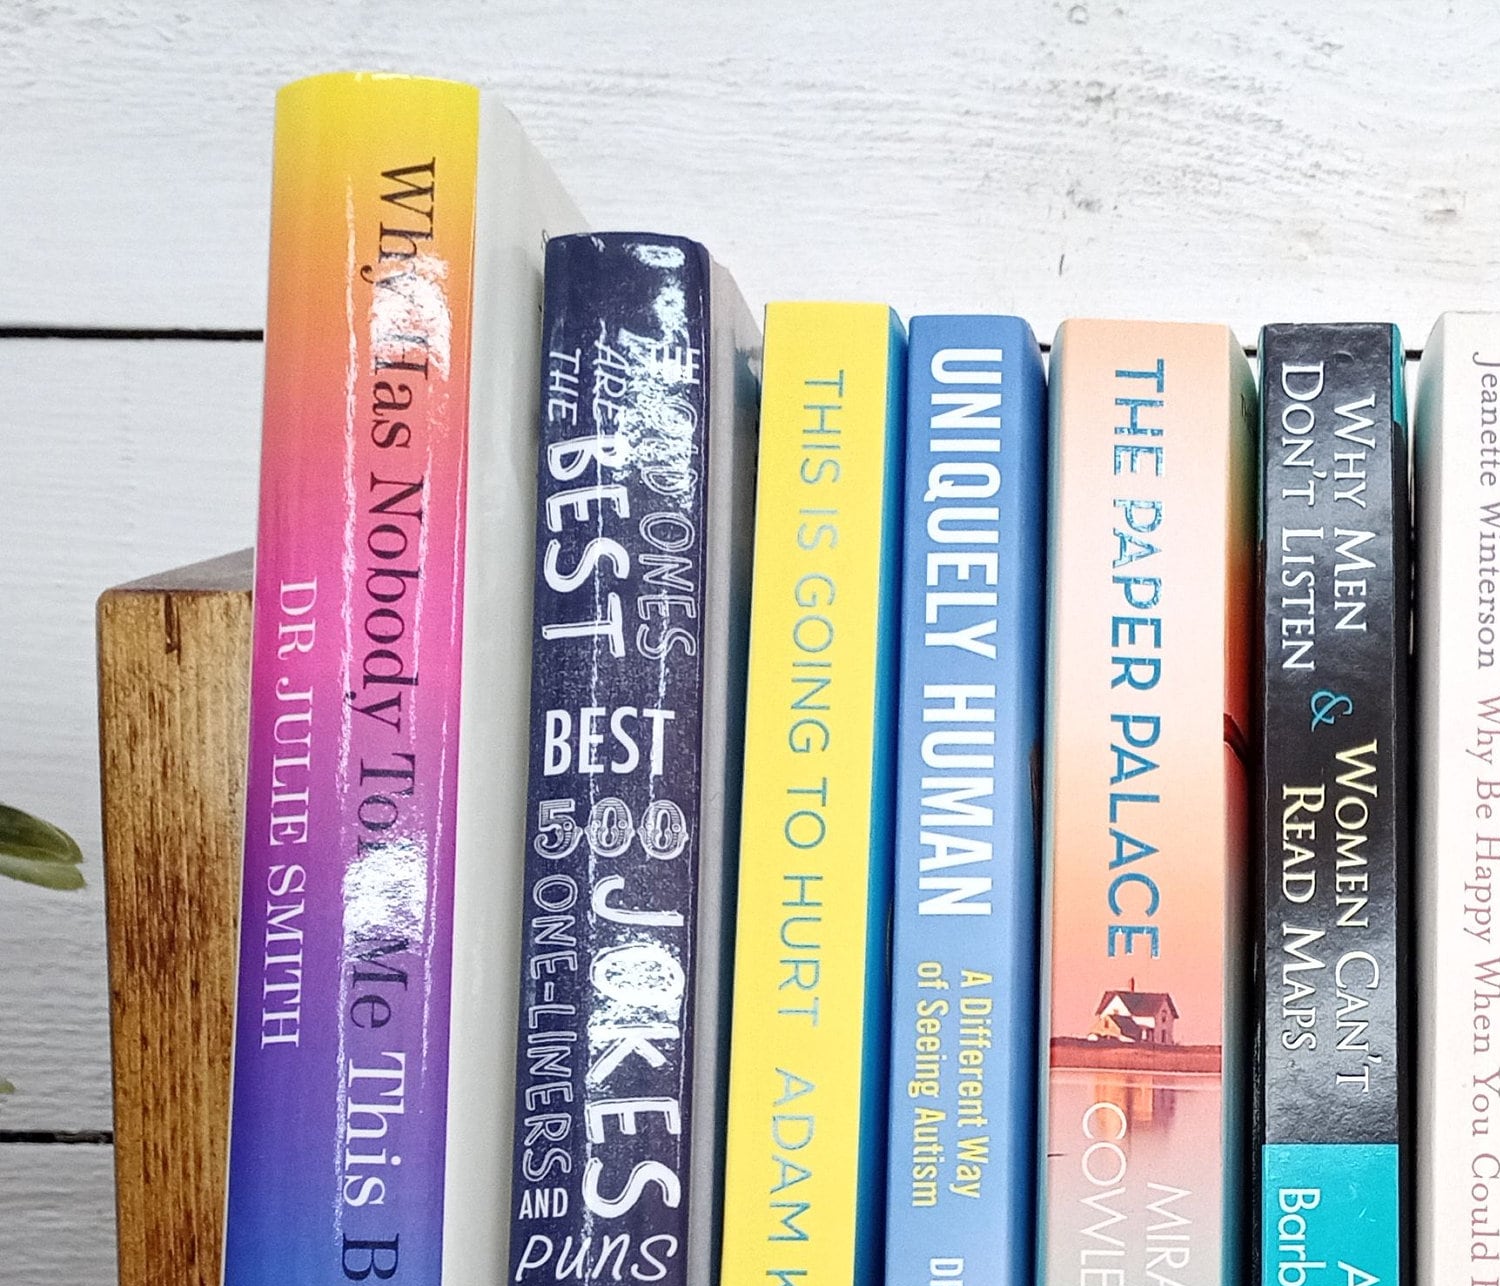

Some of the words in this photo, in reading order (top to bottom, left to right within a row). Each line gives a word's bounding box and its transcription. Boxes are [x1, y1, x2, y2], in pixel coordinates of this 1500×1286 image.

[360, 156, 436, 299] Why
[369, 331, 430, 449] Has
[547, 347, 582, 426] THE
[592, 341, 630, 428] ARE
[799, 369, 846, 485] THIS
[1113, 357, 1165, 478] THE
[541, 434, 630, 659] BEST
[796, 507, 838, 552] IS
[923, 347, 1003, 660] UNIQUELY
[277, 577, 318, 661] DR
[345, 471, 427, 733] Nobody
[637, 511, 697, 660] ONES
[1110, 498, 1164, 691] PAPER
[788, 573, 837, 754] GOING
[1310, 690, 1353, 732] &
[268, 679, 314, 846] JULIE
[544, 706, 676, 776] BEST
[918, 683, 997, 917] HUMAN
[533, 797, 690, 860] 500
[784, 776, 829, 850] TO
[1107, 713, 1161, 959] PALACE
[261, 865, 308, 1049] SMITH
[349, 936, 409, 1030] Me
[776, 873, 824, 1027] HURT
[916, 961, 943, 995] of
[960, 968, 993, 990] A
[521, 874, 578, 1182] ONE-LINERS
[581, 874, 686, 1220] JOKES
[908, 998, 949, 1101] Seeing
[957, 996, 993, 1128] Different
[342, 1051, 406, 1208] This
[766, 1066, 816, 1243] ADAM
[912, 1106, 947, 1208] Autism
[948, 1135, 990, 1200] Way
[515, 1232, 678, 1281] puns
[519, 1187, 569, 1220] AND
[1470, 1152, 1500, 1262] Could
